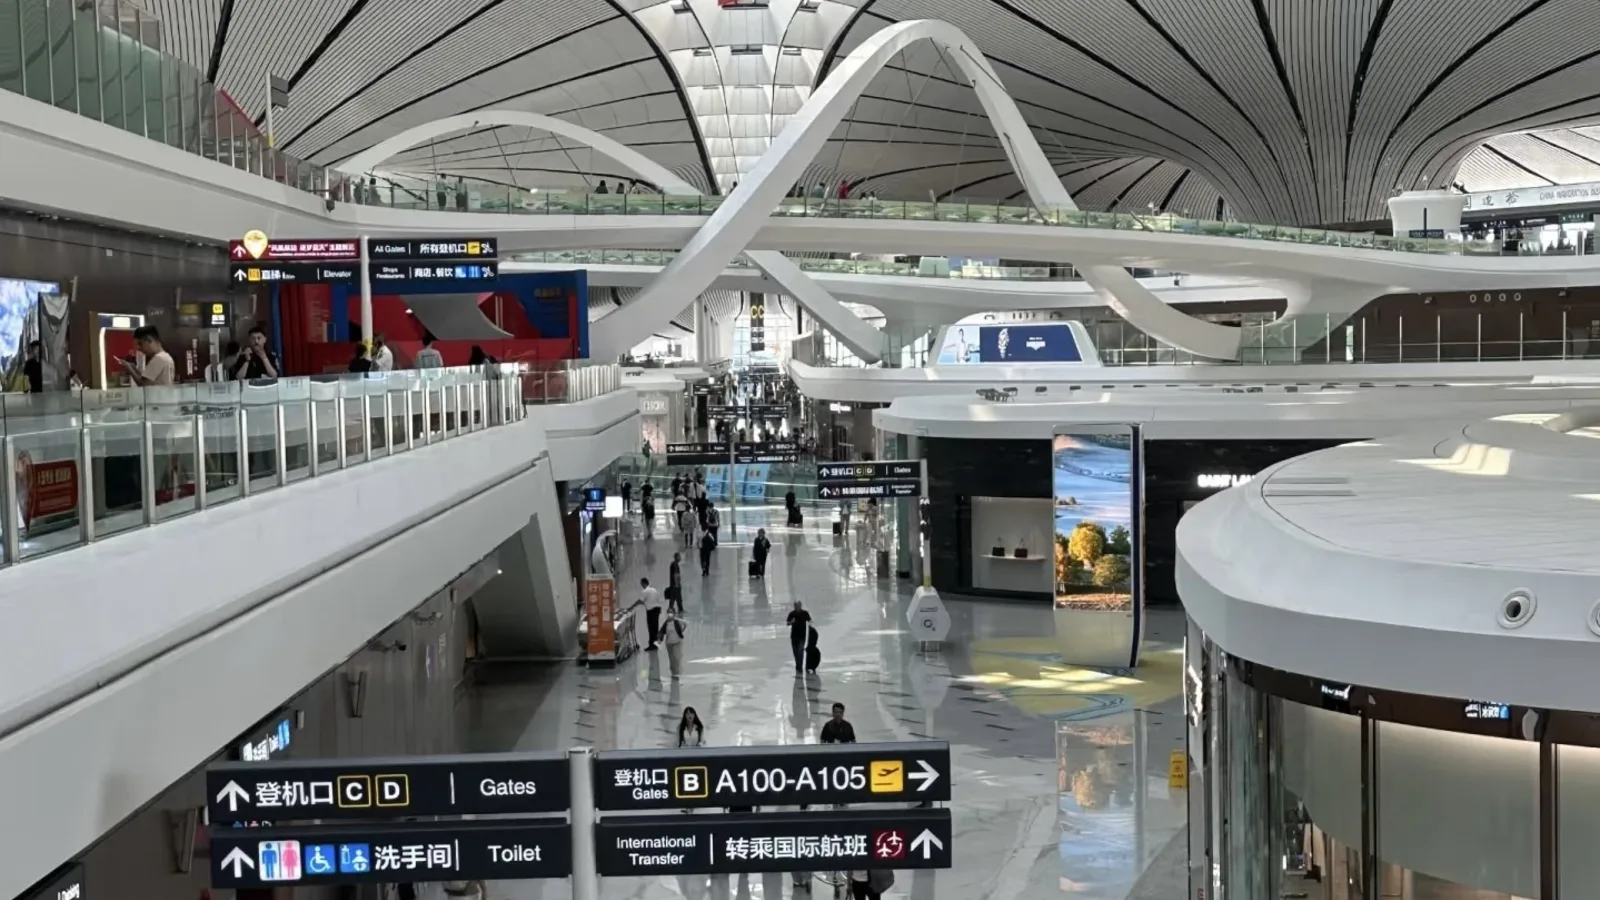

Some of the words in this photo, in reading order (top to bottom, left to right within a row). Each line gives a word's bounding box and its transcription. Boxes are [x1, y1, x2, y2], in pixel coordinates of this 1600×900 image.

[420, 243, 467, 254] 所有登机口
[479, 778, 537, 797] Gates
[614, 768, 669, 787] 登机口
[683, 773, 700, 792] B
[715, 765, 866, 794] A100-A105
[256, 780, 334, 807] 登机口
[345, 781, 363, 801] C
[383, 781, 400, 800] D
[632, 788, 669, 800] Gates
[616, 835, 696, 849] International
[725, 834, 868, 860] 转乘国际航班
[374, 843, 452, 870] 洗手间
[487, 844, 542, 863] Toilet
[628, 852, 685, 866] Transfer
